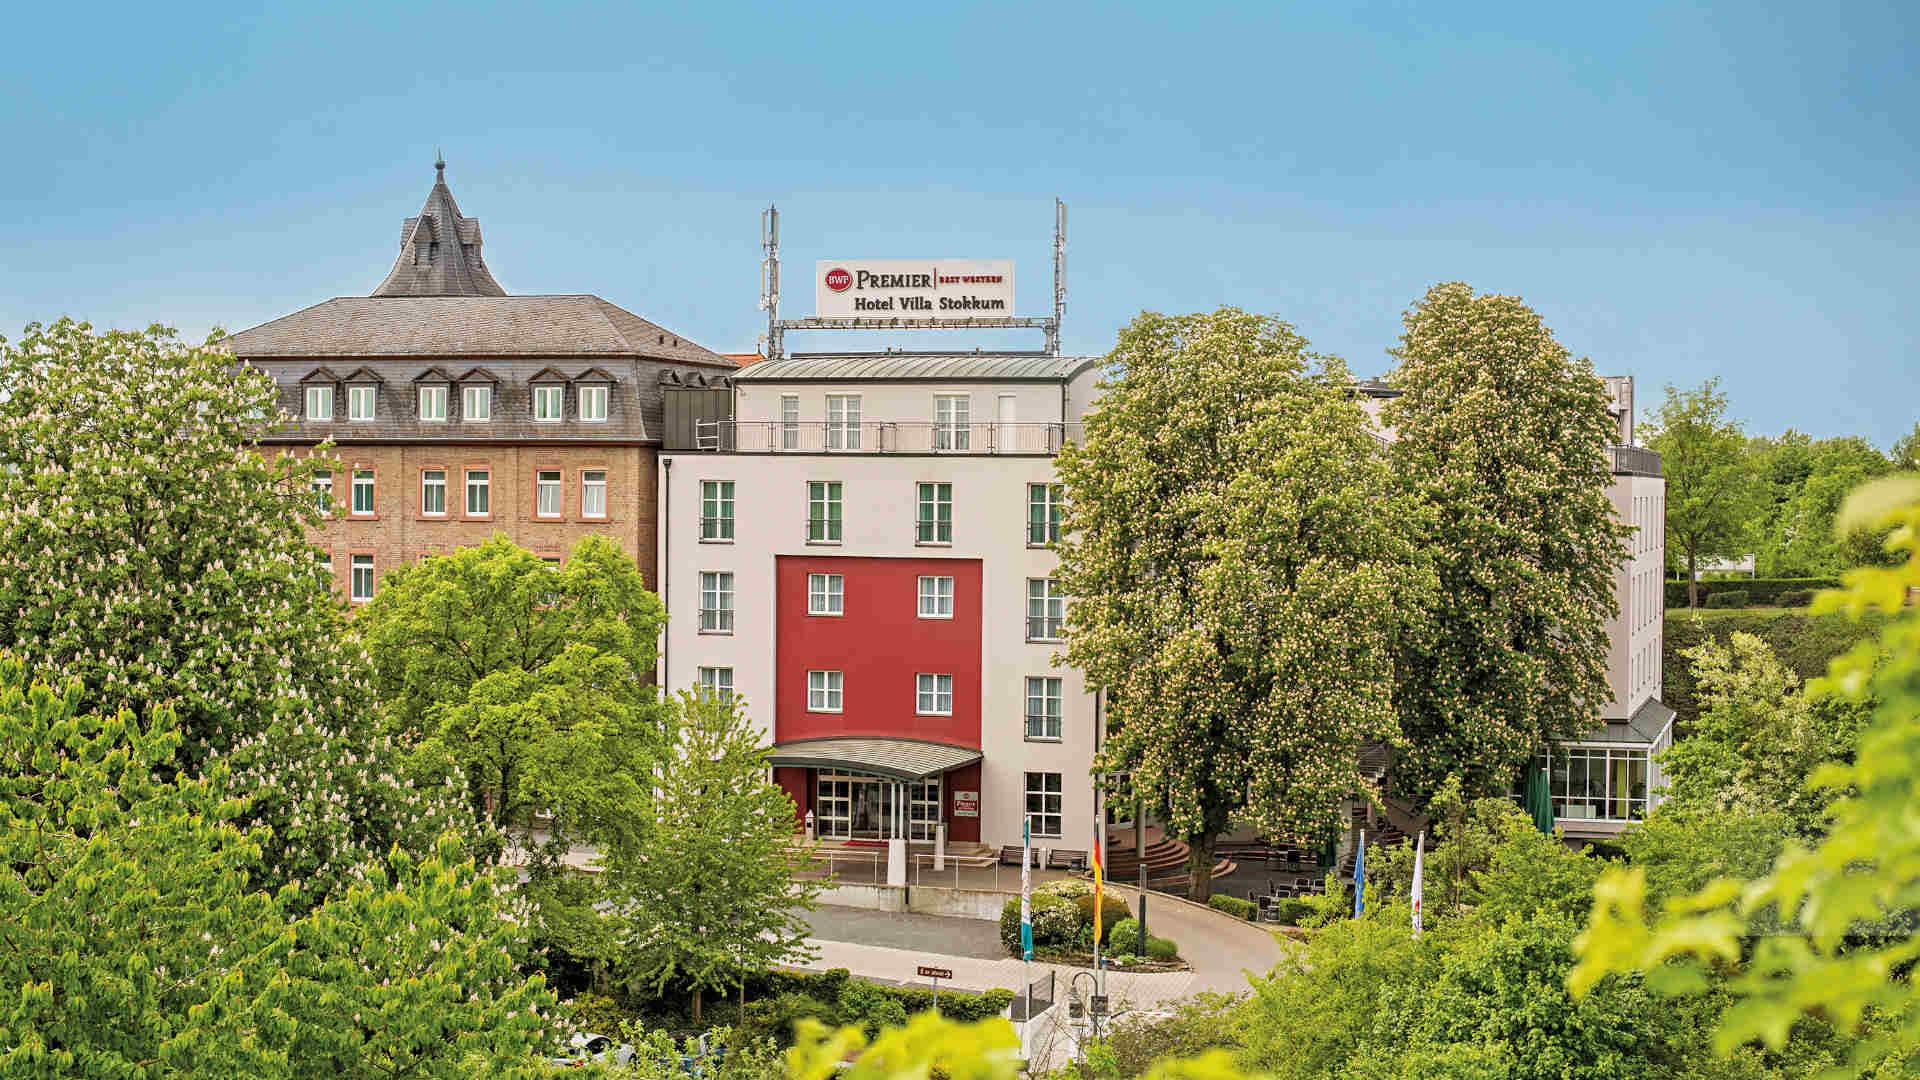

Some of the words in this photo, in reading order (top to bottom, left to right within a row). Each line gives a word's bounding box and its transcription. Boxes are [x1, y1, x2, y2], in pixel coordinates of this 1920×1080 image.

[856, 270, 932, 289] PREMIER
[938, 275, 960, 284] BEST
[962, 275, 1003, 284] WESTERN
[855, 297, 893, 310] Hotel
[899, 296, 932, 310] Villa
[939, 296, 1004, 310] Stokkum
